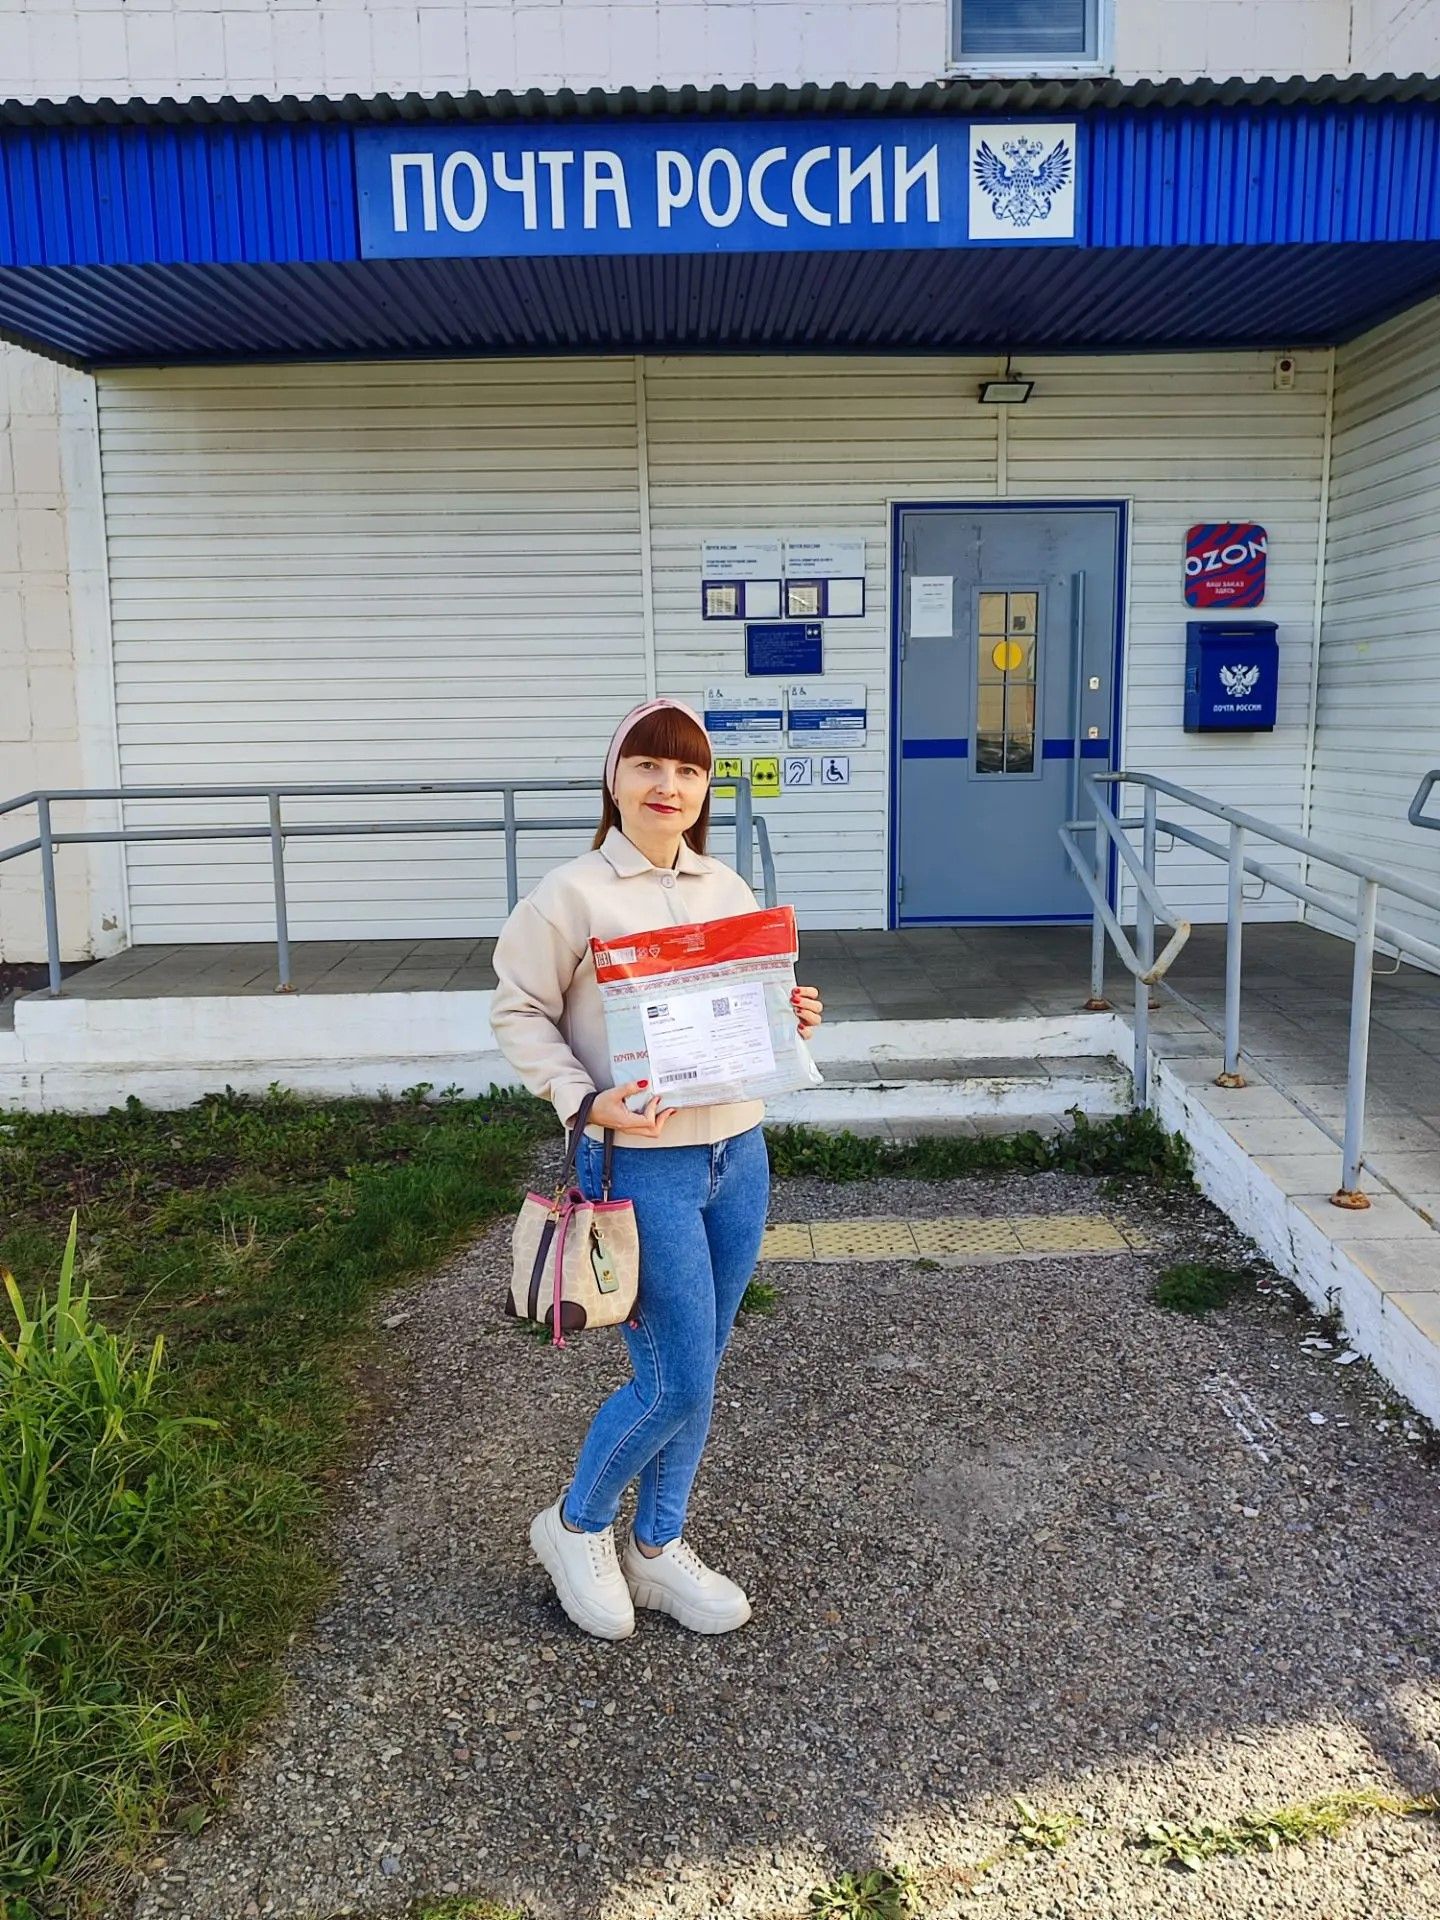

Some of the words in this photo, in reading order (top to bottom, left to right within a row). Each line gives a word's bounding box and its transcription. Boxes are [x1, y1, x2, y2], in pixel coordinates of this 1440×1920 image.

[389, 149, 631, 232] ПОЧТА
[656, 143, 940, 228] РОССИИ
[1185, 536, 1268, 576] OZON
[1213, 704, 1235, 712] ПОЧТА
[1236, 704, 1262, 712] РОССИИ
[636, 1050, 649, 1060] РОС
